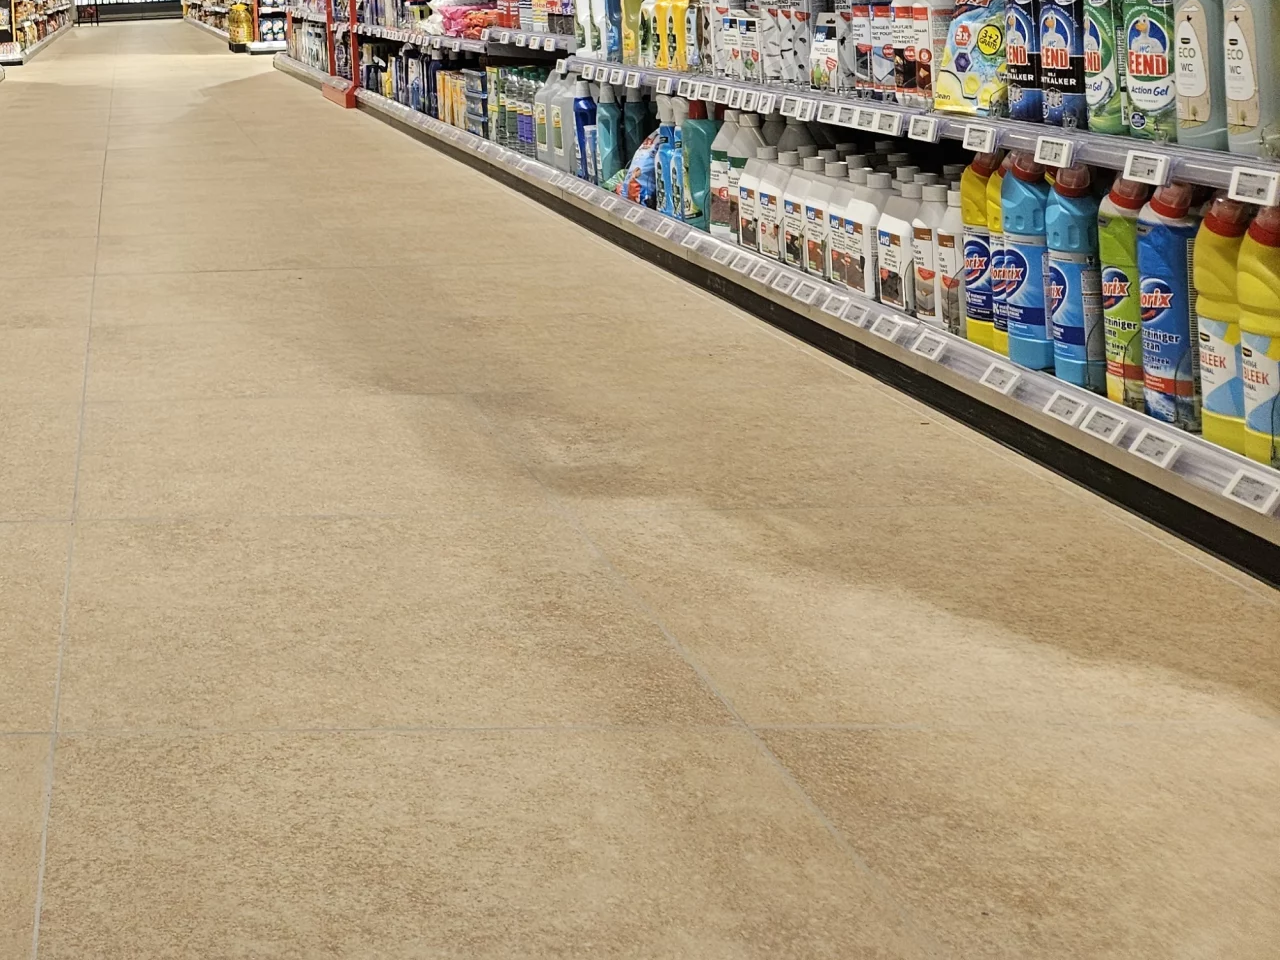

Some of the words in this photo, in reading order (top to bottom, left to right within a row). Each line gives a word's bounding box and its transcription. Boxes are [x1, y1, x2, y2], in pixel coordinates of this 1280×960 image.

[982, 29, 999, 41] 3+2
[979, 37, 998, 50] GRATIS
[1139, 44, 1150, 53] WC
[1178, 47, 1196, 59] ECO
[1227, 48, 1244, 60] ECO
[1128, 50, 1168, 76] EEND
[1180, 62, 1194, 73] WC
[1229, 65, 1242, 75] WC
[1040, 76, 1077, 86] NTKALKER
[1131, 86, 1152, 96] Action
[1153, 85, 1170, 97] Gel
[880, 235, 890, 245] HG
[964, 253, 987, 269] orix
[1006, 264, 1024, 280] rix
[1102, 277, 1132, 297] orix
[1140, 288, 1174, 308] orix
[1104, 316, 1138, 331] reiniger
[1142, 341, 1160, 352] cean
[1200, 353, 1227, 369] BLEEK
